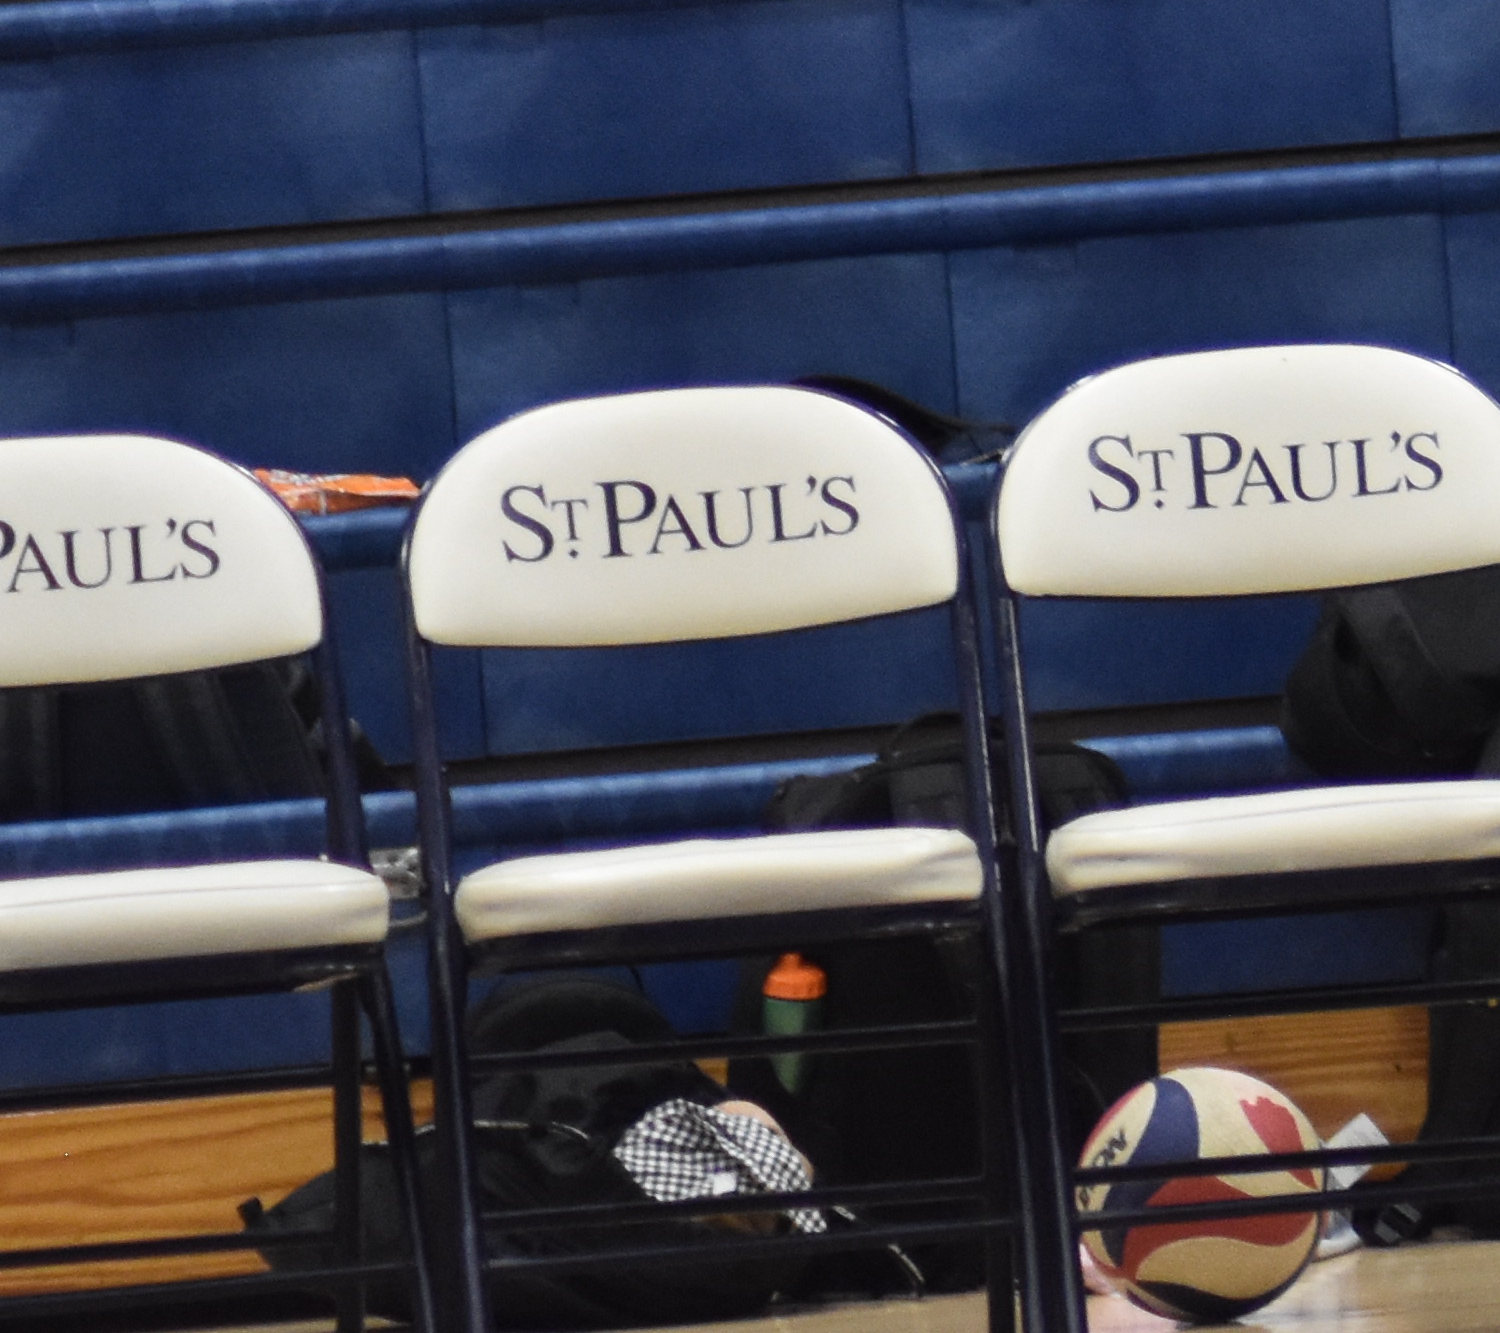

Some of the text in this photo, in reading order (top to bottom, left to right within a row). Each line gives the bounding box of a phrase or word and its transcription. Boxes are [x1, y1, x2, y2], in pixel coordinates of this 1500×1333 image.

[1179, 429, 1444, 511] PAUL'S
[0, 516, 221, 593] AUL'S
[594, 474, 860, 560] PAUL'S
